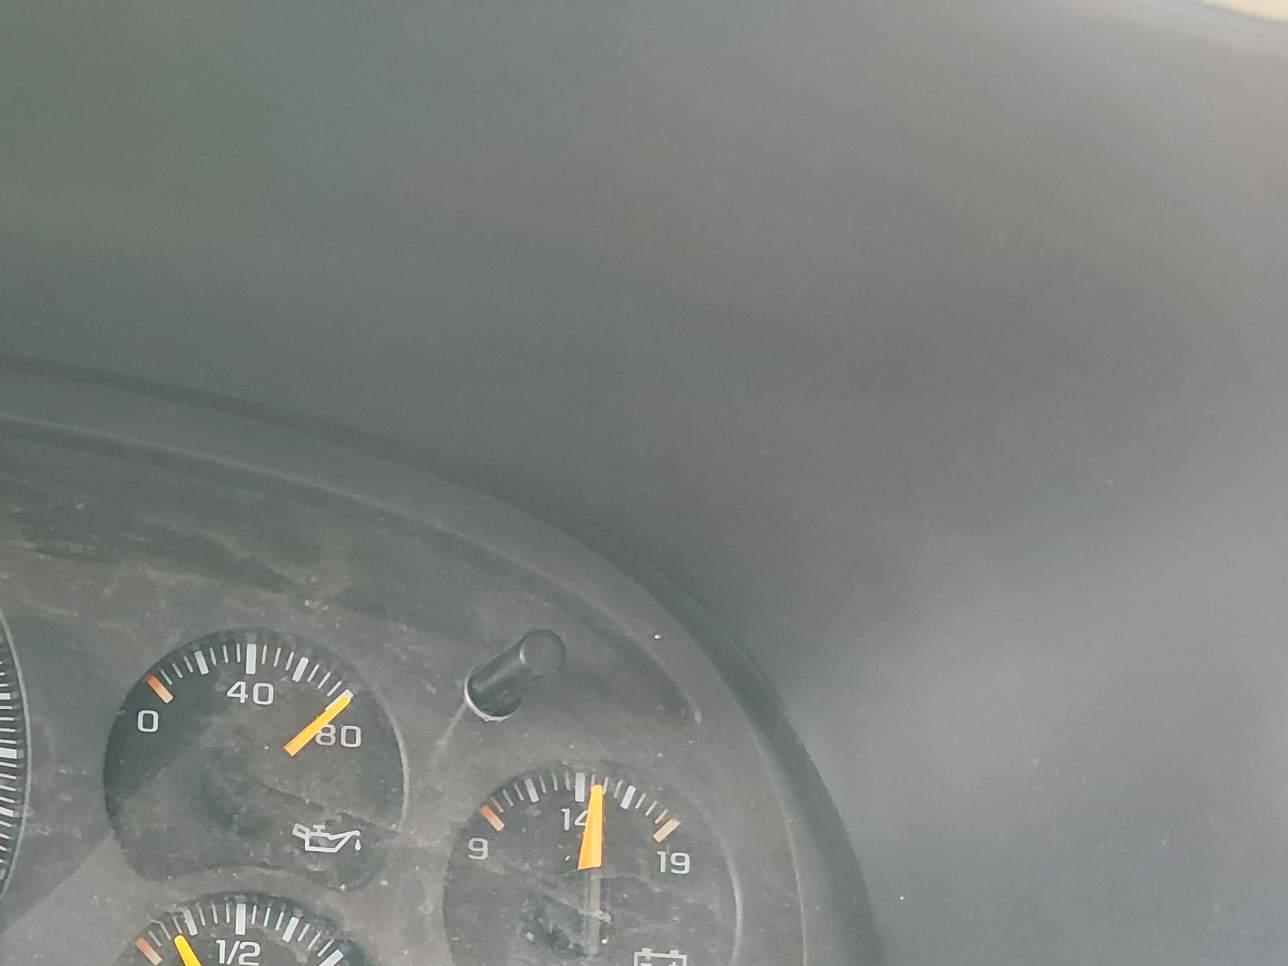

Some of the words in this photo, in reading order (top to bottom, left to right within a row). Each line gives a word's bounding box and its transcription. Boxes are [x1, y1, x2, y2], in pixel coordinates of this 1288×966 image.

[226, 680, 274, 705] 40
[137, 709, 159, 733] 0
[315, 724, 361, 748] 80
[468, 837, 489, 861] 9
[656, 850, 691, 875] 19
[215, 939, 261, 966] 1/2
